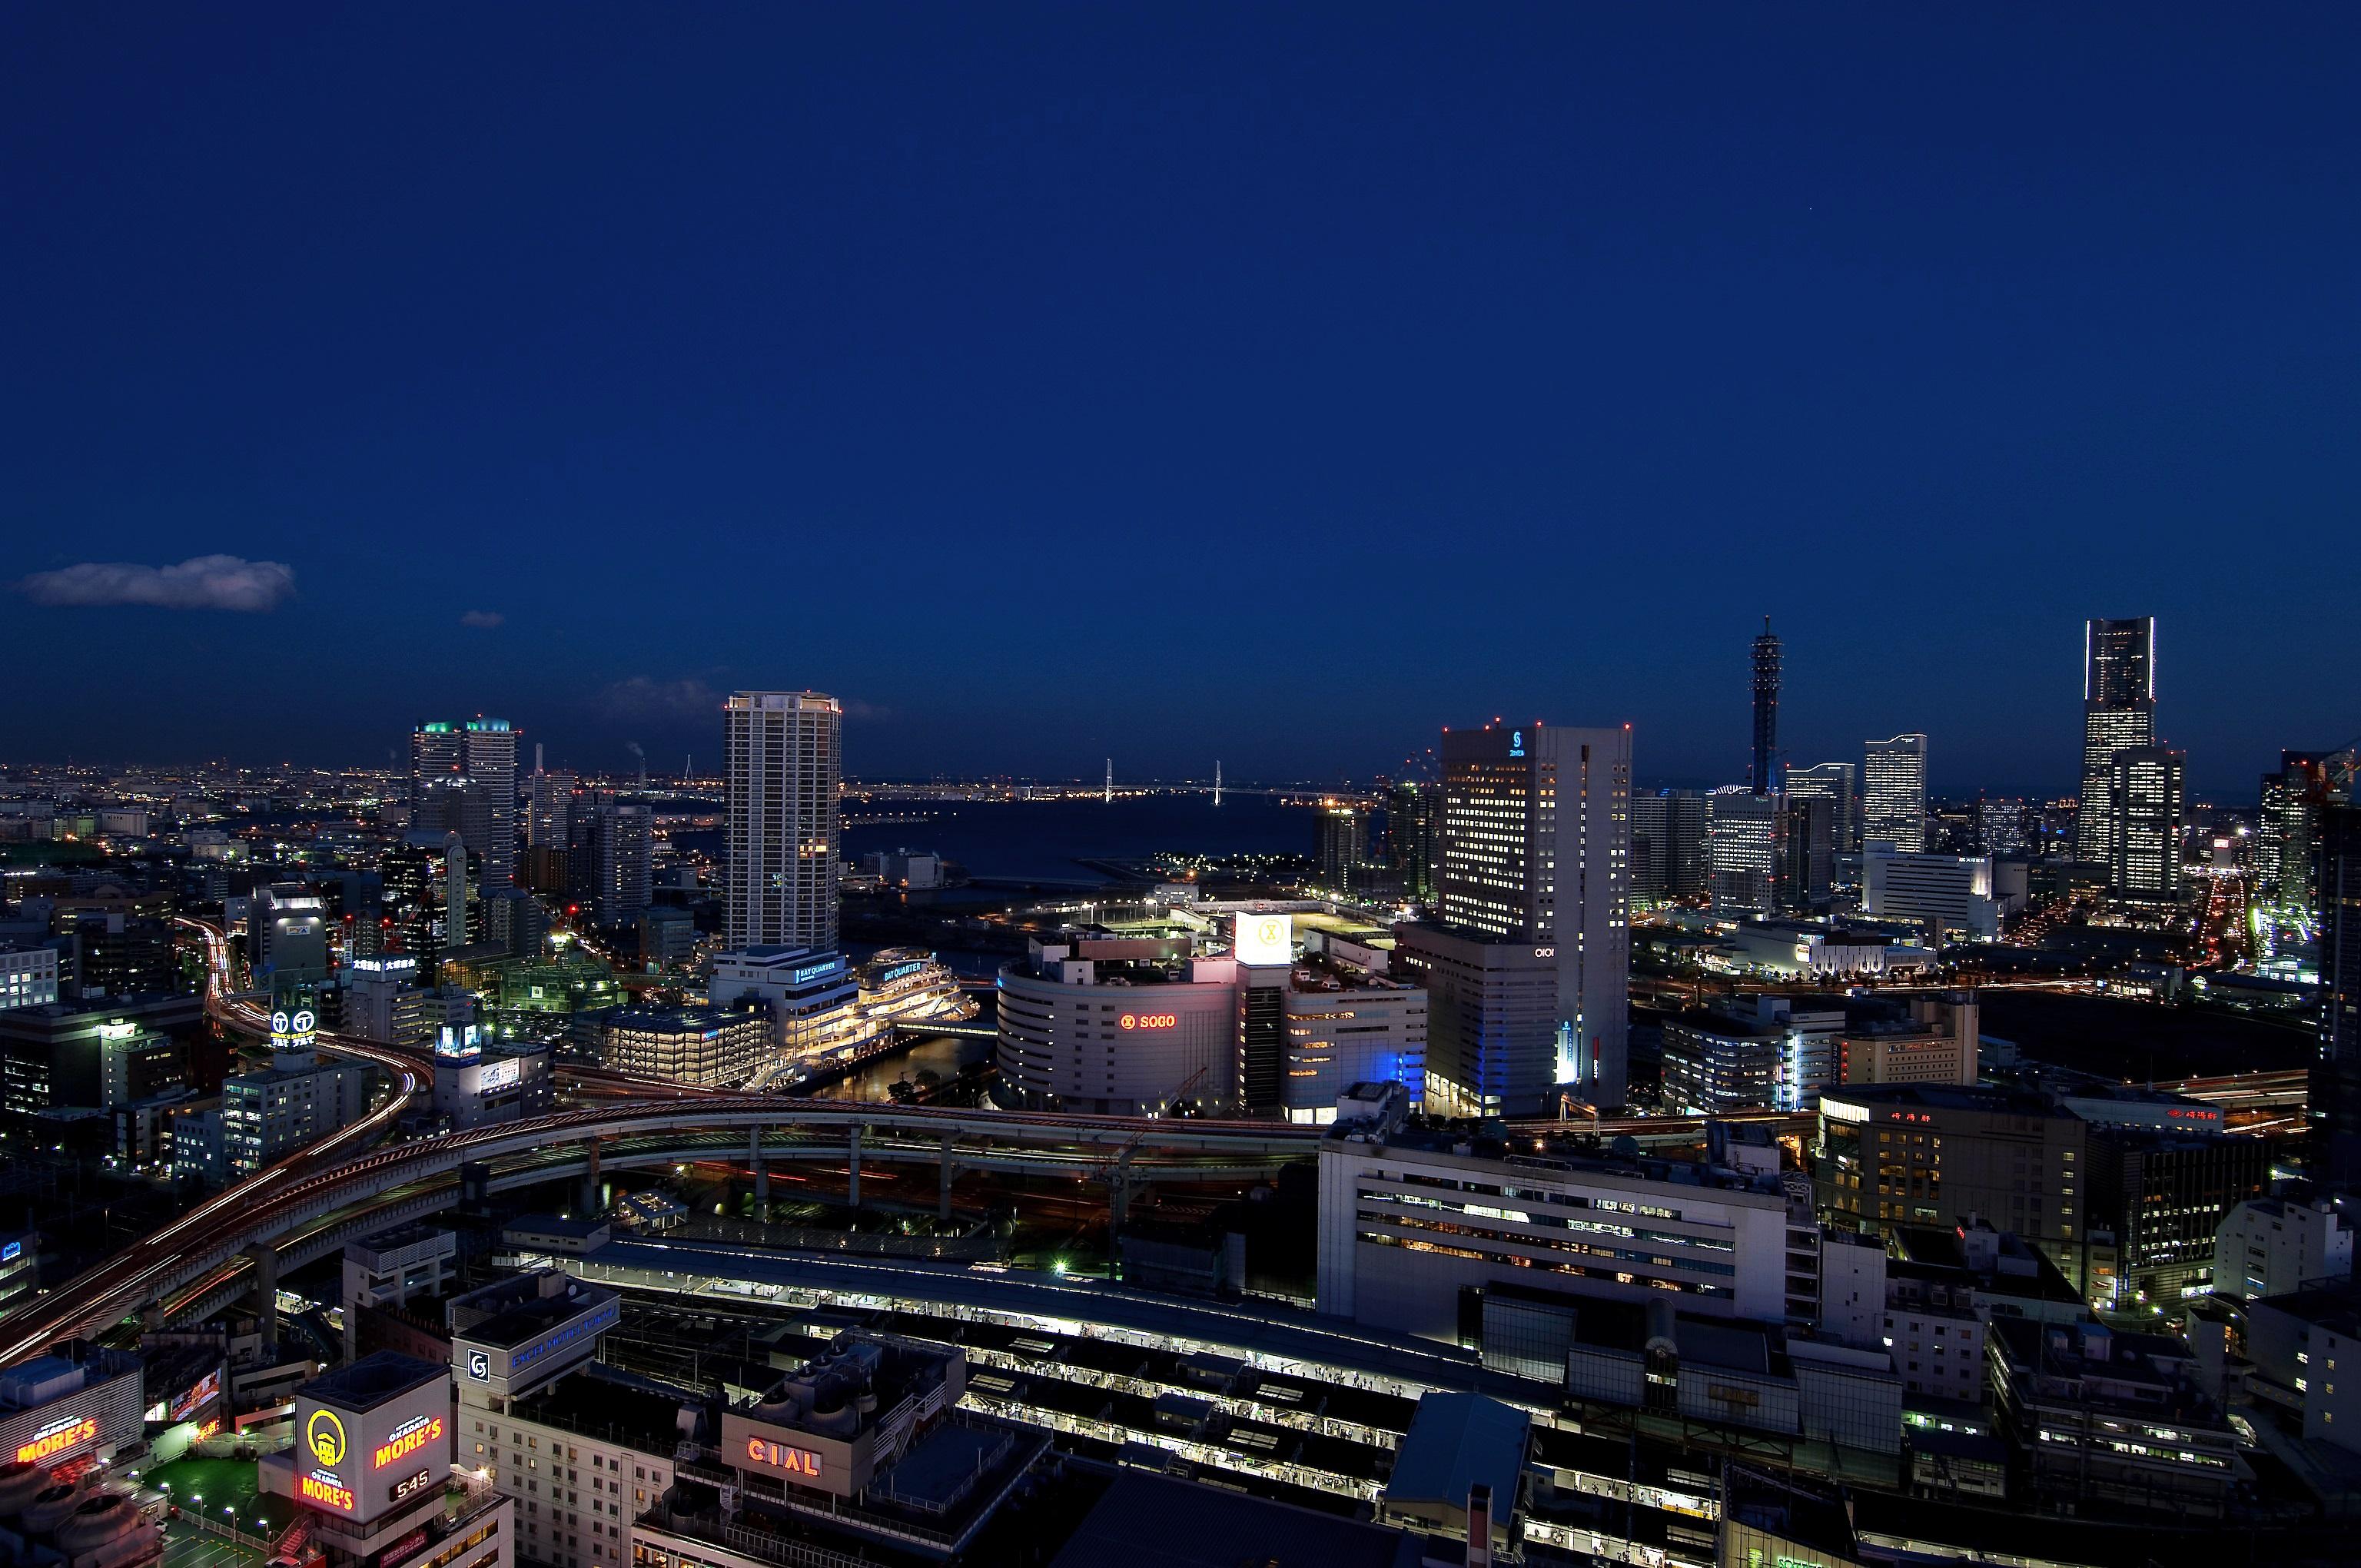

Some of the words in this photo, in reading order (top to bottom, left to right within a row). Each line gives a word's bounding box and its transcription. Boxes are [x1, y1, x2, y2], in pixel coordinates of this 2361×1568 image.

[885, 970, 894, 982] BAY
[894, 962, 921, 978] QUARTER
[1140, 1015, 1175, 1027] SOGO
[546, 1323, 582, 1350] HOTEL
[17, 1418, 96, 1462] MORE'S
[374, 1418, 442, 1470] MORE'S
[749, 1440, 818, 1476] CIAL
[302, 1477, 354, 1510] MORE'S
[397, 1470, 429, 1498] 5:45
